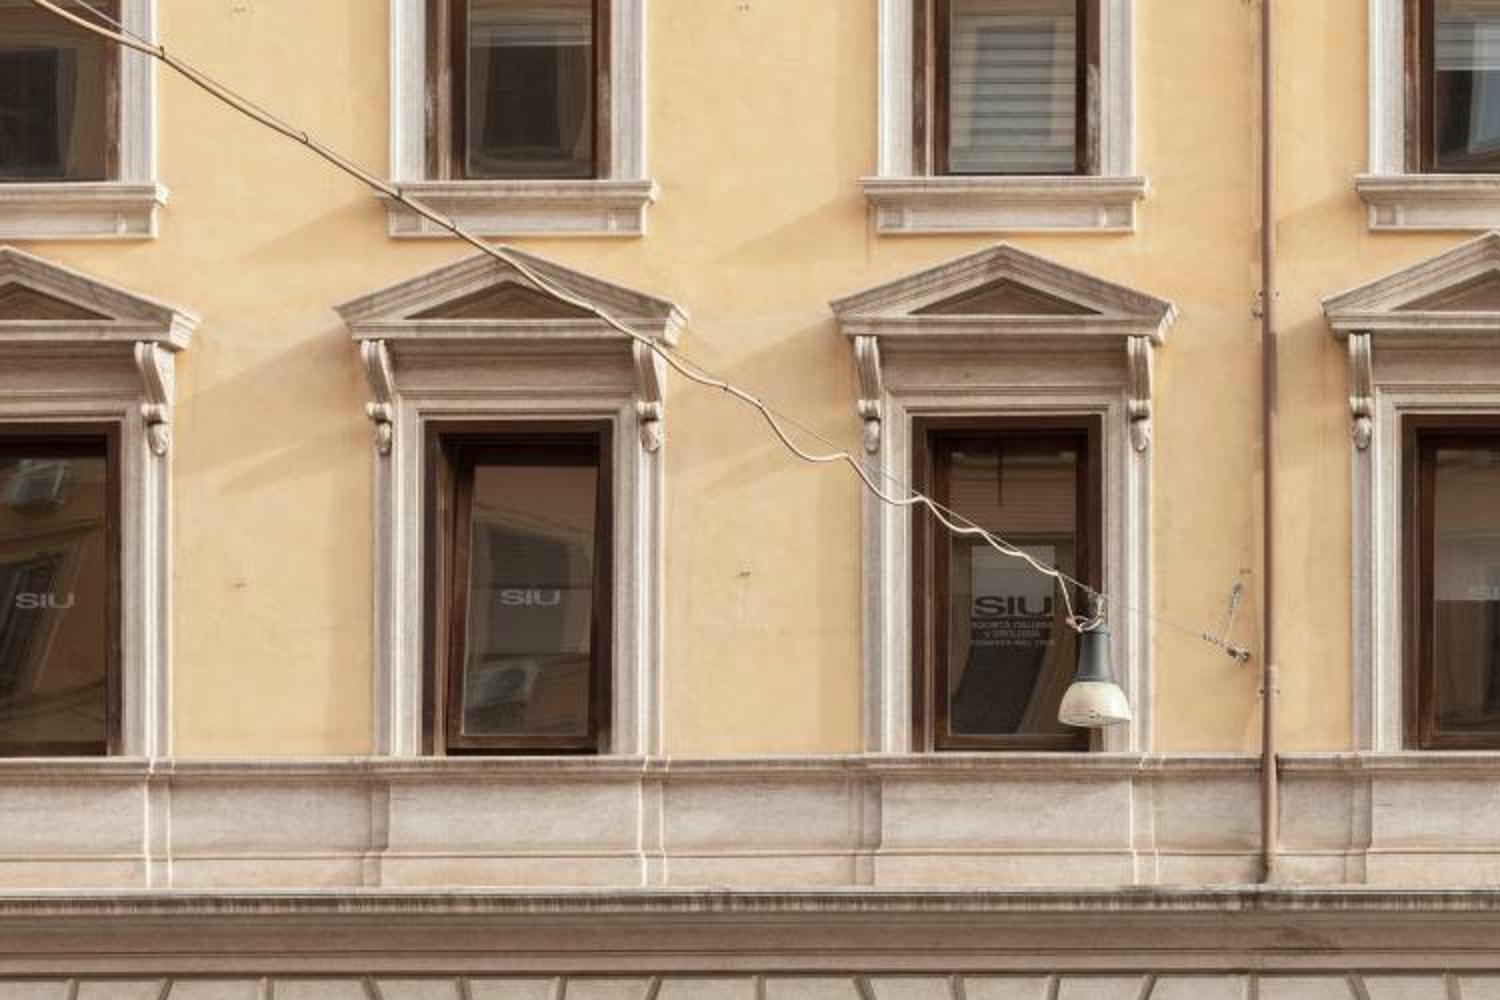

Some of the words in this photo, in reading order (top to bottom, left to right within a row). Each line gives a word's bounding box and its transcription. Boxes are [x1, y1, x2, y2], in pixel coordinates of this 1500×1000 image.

[15, 592, 75, 609] SIU
[500, 588, 561, 606] SIU
[975, 595, 1053, 617] SIU
